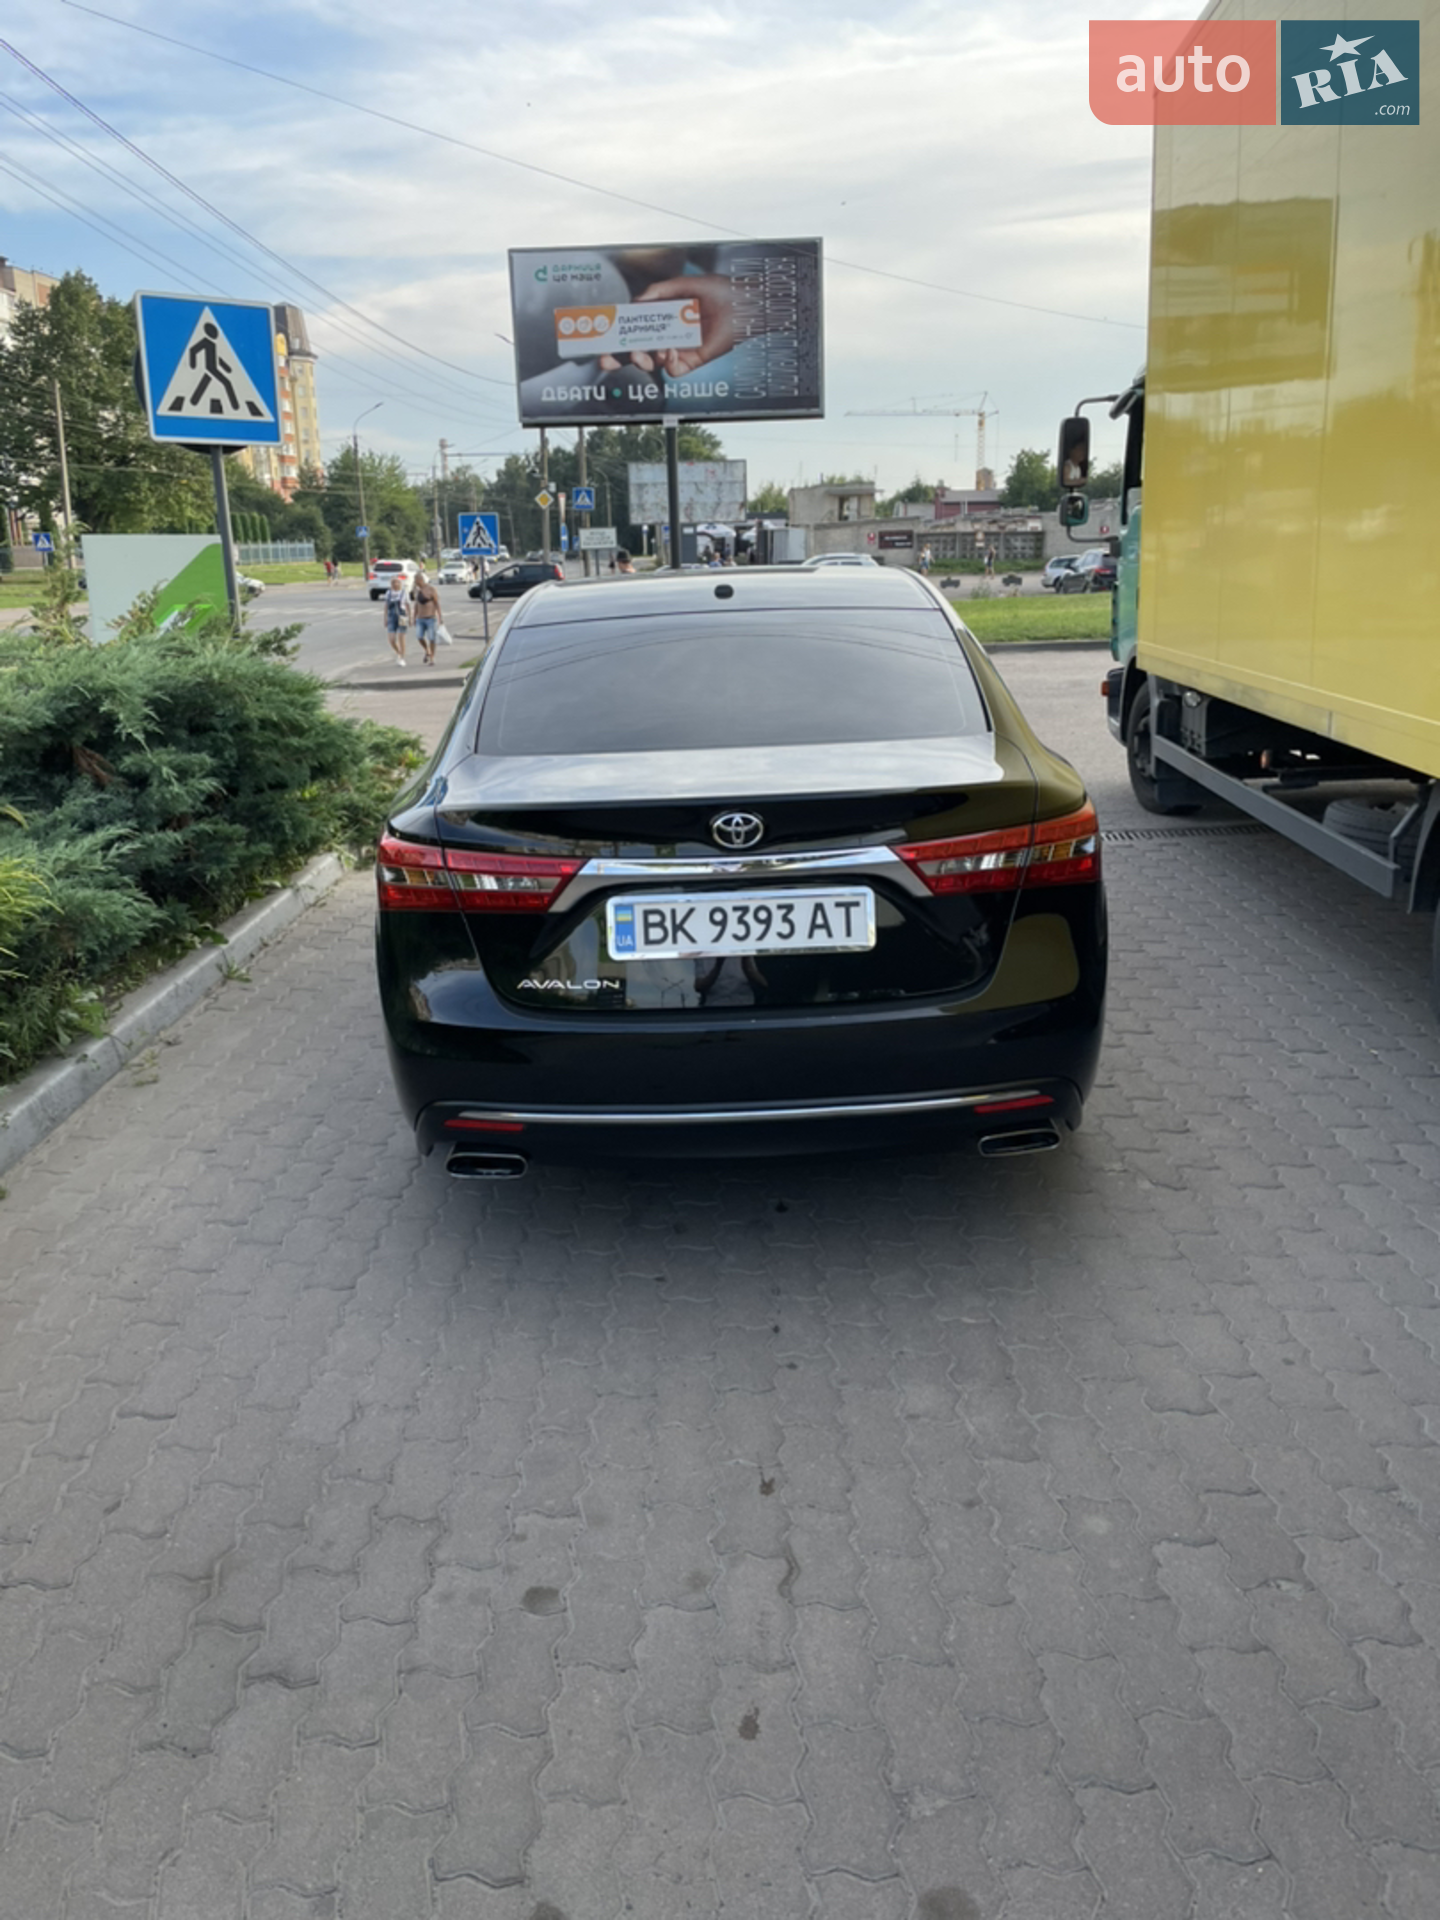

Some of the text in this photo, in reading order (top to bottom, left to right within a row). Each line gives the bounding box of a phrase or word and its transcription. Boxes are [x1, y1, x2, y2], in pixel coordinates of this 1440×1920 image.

[628, 383, 659, 403] це
[664, 380, 730, 399] наше
[708, 902, 796, 944] 9393
[616, 934, 634, 947] UA
[516, 978, 620, 990] AVALON
